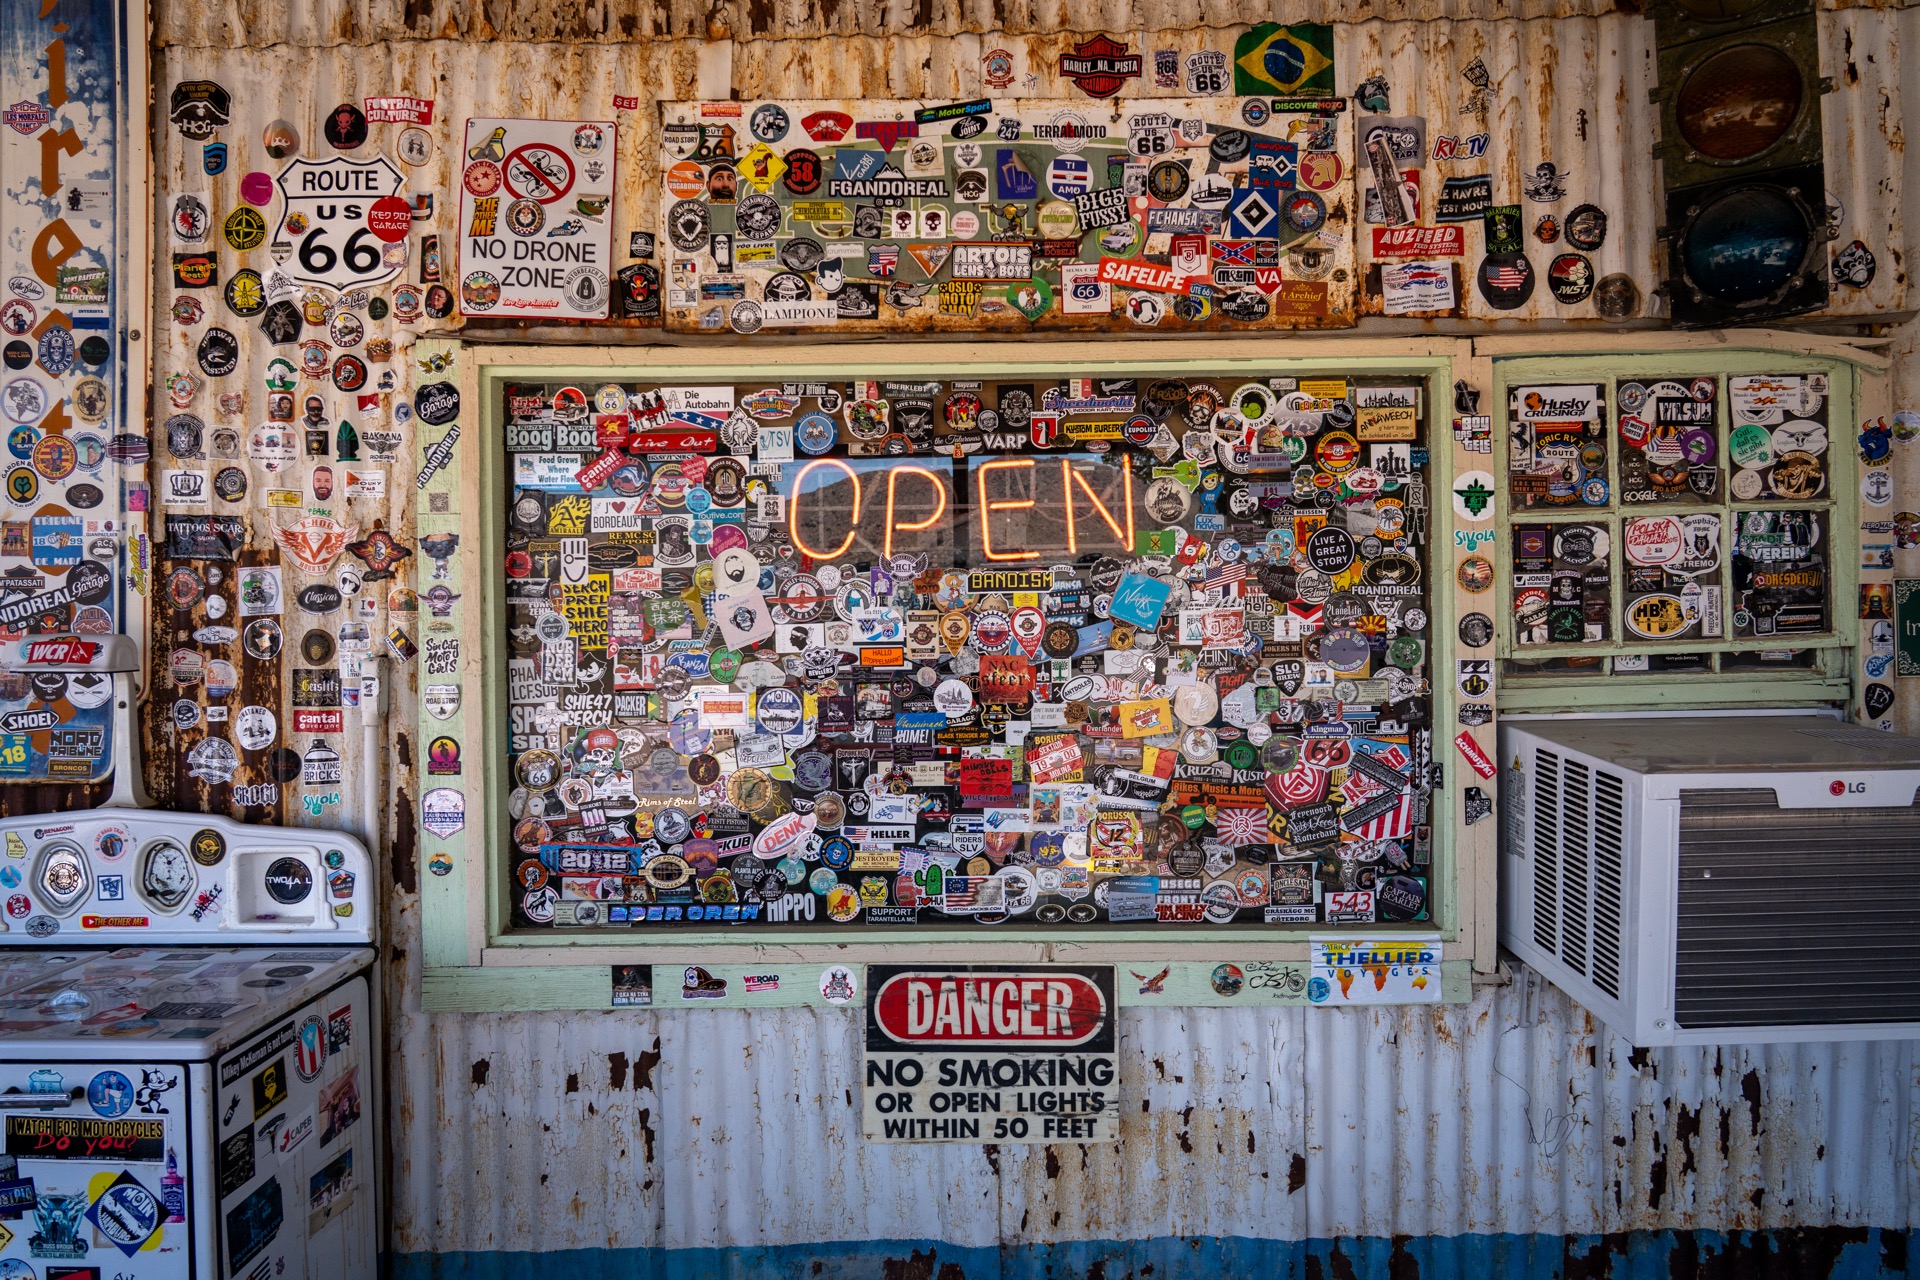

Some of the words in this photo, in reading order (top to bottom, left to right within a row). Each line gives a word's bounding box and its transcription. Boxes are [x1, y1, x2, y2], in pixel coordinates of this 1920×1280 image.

[1157, 61, 1177, 74] R66
[1191, 56, 1223, 67] ROUTE
[1196, 74, 1222, 92] 66
[366, 98, 428, 112] FOOTBALL
[616, 98, 637, 108] SEE
[1274, 101, 1344, 110] DISCOVERMOTO
[938, 101, 991, 118] MotorSport
[182, 119, 211, 133] HOG
[1134, 117, 1168, 128] ROUTE
[959, 123, 981, 138] JOINT
[1000, 126, 1018, 138] 247
[664, 136, 679, 144] ROAD
[680, 136, 698, 144] STORY
[1136, 137, 1166, 154] 66
[700, 138, 724, 156] 66
[1065, 162, 1076, 170] TI
[791, 163, 814, 182] 58
[302, 170, 379, 192] ROUTE
[668, 182, 704, 190] VAGABONDS
[830, 180, 950, 197] FGANDOREAL
[1058, 186, 1080, 194] AMO
[1452, 187, 1488, 200] HAVRE
[475, 198, 499, 212] THE
[316, 204, 362, 220] US
[474, 212, 498, 220] OTHER
[1079, 206, 1128, 231] FUSSY
[372, 222, 409, 230] GARAGE
[470, 220, 497, 237] ME
[1380, 228, 1456, 244] AUZFEED
[298, 227, 381, 275] 66
[472, 238, 506, 259] NO
[514, 240, 596, 264] DRONE
[1044, 241, 1076, 249] SUPPORT
[954, 246, 1031, 264] ARTOIS
[954, 264, 984, 278] LENS
[999, 264, 1032, 278] BOYS
[1102, 262, 1186, 290] SAFELIFE
[1256, 270, 1280, 284] VA
[500, 266, 565, 289] ZONE
[948, 282, 974, 292] OSLO
[1077, 286, 1095, 297] 66
[1556, 284, 1590, 295] JWST
[59, 292, 106, 302] VALENCIENNES
[1222, 301, 1238, 311] IRON
[1253, 302, 1267, 312] ART
[764, 308, 836, 320] LAMPIONE
[886, 382, 928, 392] ÜBERKLEBT
[684, 390, 700, 400] Die
[420, 393, 459, 418] Garage
[684, 400, 730, 409] Autobahn
[1045, 396, 1134, 410] Speedworld
[1540, 398, 1590, 412] Husky
[1524, 408, 1586, 418] CRUISING.pl
[506, 426, 552, 451] Boog
[632, 438, 668, 448] Live
[682, 438, 713, 448] Out
[770, 432, 791, 448] TSV
[983, 434, 1026, 450] VARP
[538, 456, 558, 464] Food
[558, 456, 579, 464] Grows
[1546, 450, 1575, 458] ROUTE
[547, 465, 570, 474] Where
[581, 451, 616, 484] cantal
[538, 474, 556, 484] Water
[1624, 490, 1658, 502] GOGGLE
[789, 452, 1136, 561] OPEN
[34, 516, 83, 526] TRIBUNE
[300, 518, 334, 530] V-HOG
[593, 516, 639, 528] BORDEAUX
[608, 532, 623, 540] RE
[624, 532, 640, 540] MC
[642, 531, 656, 539] SC
[1562, 526, 1591, 537] FIGHTER
[1314, 536, 1336, 546] LIVE
[1338, 536, 1346, 544] A
[1316, 546, 1346, 556] GREAT
[1750, 546, 1806, 560] VEREIN
[34, 558, 50, 566] DE
[52, 557, 82, 566] MARS
[1317, 556, 1348, 566] STORY
[1564, 555, 1591, 564] FACTORY
[72, 574, 110, 594] Garage
[972, 573, 1053, 589] BANDISM
[1764, 573, 1809, 588] DRESDEN
[1352, 584, 1423, 595] FGANDOREAL
[565, 595, 608, 606] PREL
[566, 606, 608, 618] SHIE
[786, 606, 820, 620] SAMARA
[32, 642, 68, 661] WCR
[1262, 644, 1289, 652] JOKERS
[1290, 644, 1301, 652] MC
[424, 652, 451, 666] Moto
[546, 654, 574, 667] DER
[862, 656, 903, 665] STOPPELMARKT
[988, 660, 1019, 672] NAC
[1275, 662, 1300, 674] SLO
[546, 668, 574, 682] FCM
[982, 670, 1026, 686] sfeer
[1276, 672, 1300, 682] BREW
[512, 686, 558, 700] LCF.SUB
[766, 690, 792, 702] MOIN
[564, 694, 612, 710] SHIE47
[614, 696, 646, 712] PACKER
[8, 712, 52, 730] SHOEI
[298, 714, 340, 724] cantal
[566, 710, 612, 726] SERCH
[1086, 724, 1122, 733] Overlander
[1310, 726, 1344, 735] Kingman
[53, 764, 88, 772] BRONCOS
[304, 762, 340, 772] SPRAYING
[1174, 764, 1223, 778] KRUZIN
[304, 770, 340, 781] BRICKS
[1128, 773, 1156, 784] BELGIUM
[1848, 782, 1866, 794] LG
[764, 818, 807, 851] DENK
[870, 830, 910, 839] HELLER
[955, 836, 982, 844] RIDERS
[959, 844, 978, 852] SLV
[1386, 886, 1422, 902] CAPTAIN
[768, 892, 816, 922] HIPPO
[1331, 892, 1372, 914] 543
[1382, 892, 1421, 912] SCARLET
[872, 908, 911, 916] SUPPORT
[1158, 912, 1202, 922] RACING
[94, 916, 108, 926] THE
[108, 916, 130, 926] OTHER
[131, 917, 144, 926] ME
[1322, 952, 1434, 965] THELLIER
[1327, 966, 1429, 978] VOYAGES
[743, 974, 780, 984] WEROAD
[907, 980, 1074, 1036] DANGER
[866, 1058, 924, 1087] NO
[938, 1058, 1114, 1088] SMOKING
[875, 1092, 913, 1114] OR
[929, 1091, 1000, 1114] OPEN
[1016, 1091, 1106, 1114] LIGHTS
[6, 1118, 12, 1134] I
[15, 1118, 52, 1134] WATCH
[56, 1120, 78, 1136] FOR
[82, 1120, 163, 1138] MOTORCYCLES
[884, 1118, 980, 1139] WITHIN
[993, 1117, 1030, 1138] 50
[1043, 1117, 1098, 1139] FEET
[34, 1132, 70, 1150] Do
